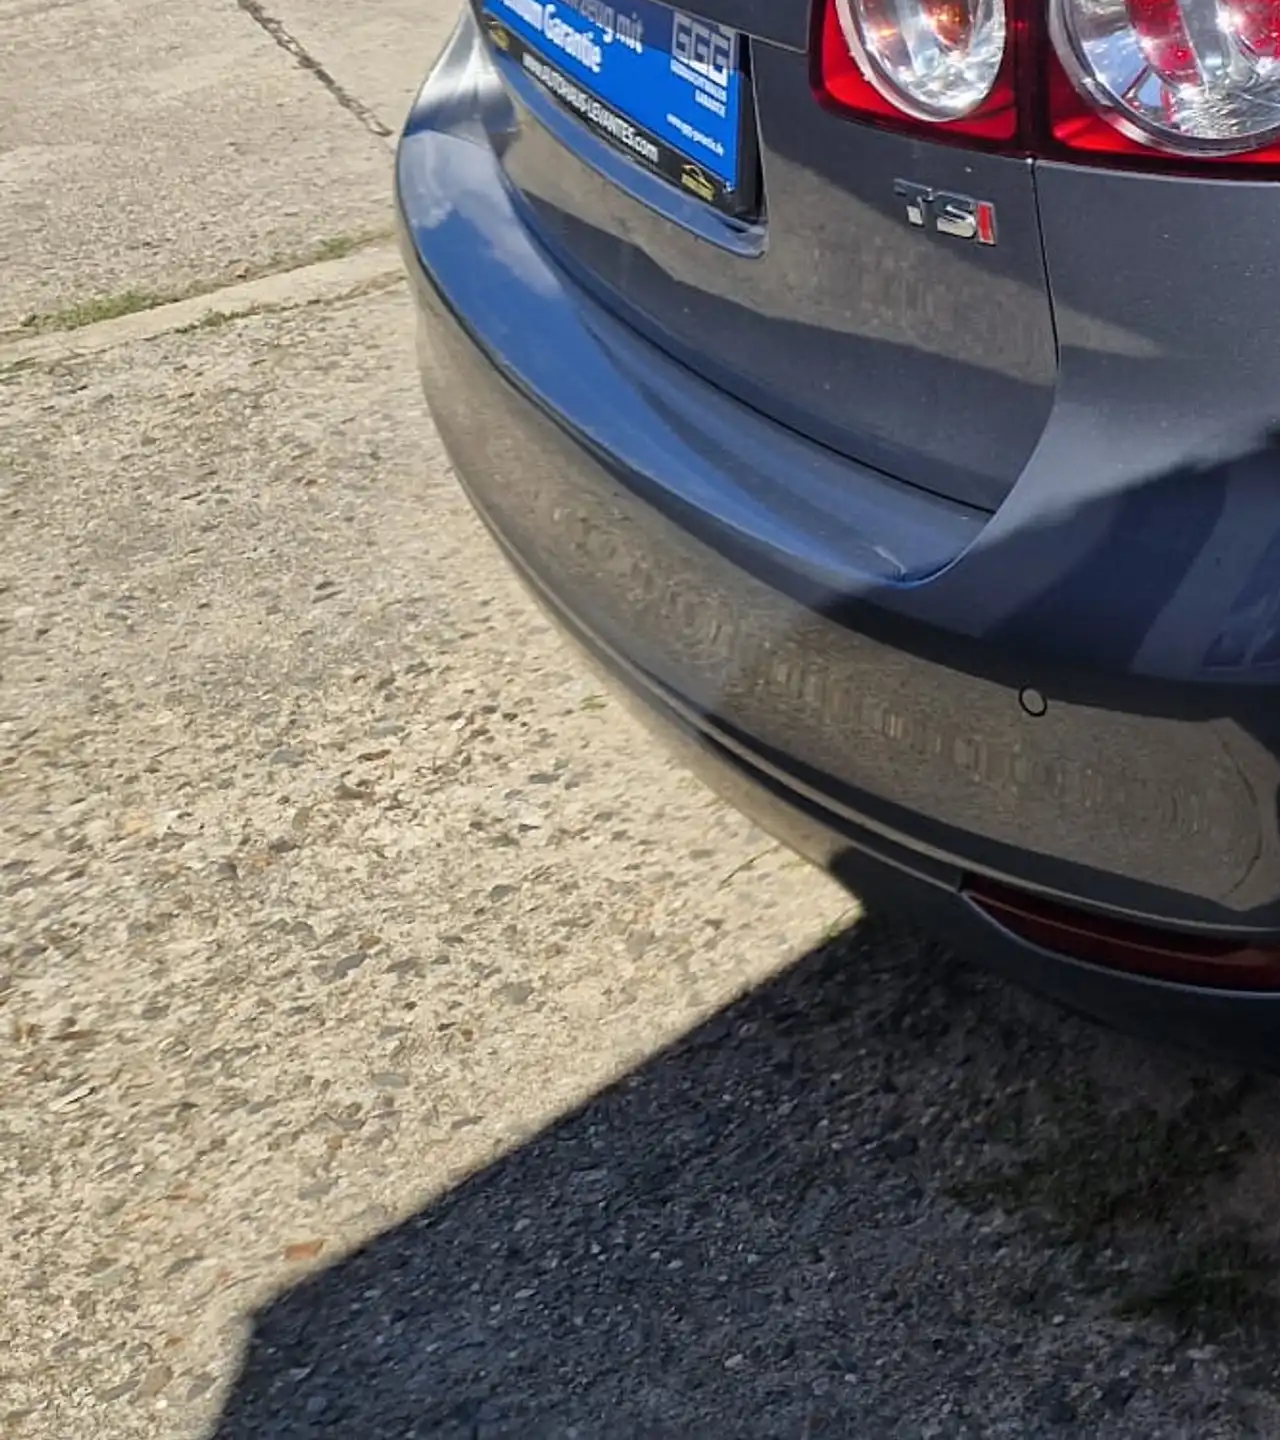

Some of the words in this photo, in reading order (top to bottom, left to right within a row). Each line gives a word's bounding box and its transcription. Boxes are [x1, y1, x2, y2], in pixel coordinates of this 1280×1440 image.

[543, 3, 602, 73] Garantie
[672, 11, 734, 87] GGG
[893, 178, 997, 246] TSI
